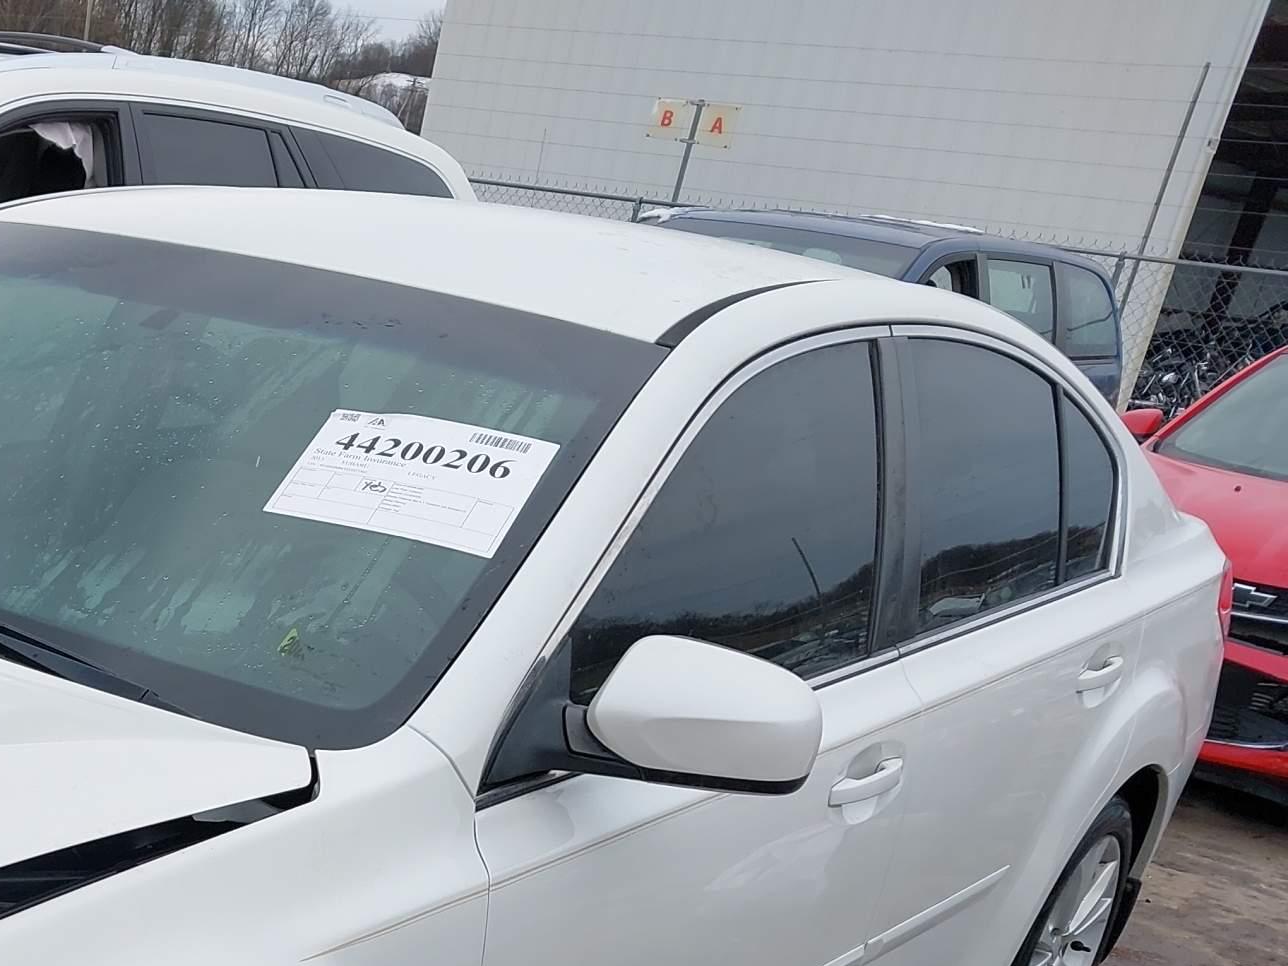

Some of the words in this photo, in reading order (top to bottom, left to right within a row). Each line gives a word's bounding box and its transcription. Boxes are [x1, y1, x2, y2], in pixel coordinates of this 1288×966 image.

[660, 110, 674, 127] B
[710, 117, 723, 134] A
[314, 447, 336, 456] State
[338, 451, 361, 461] Farm
[363, 454, 407, 468] Insurance
[336, 432, 516, 478] 44200206
